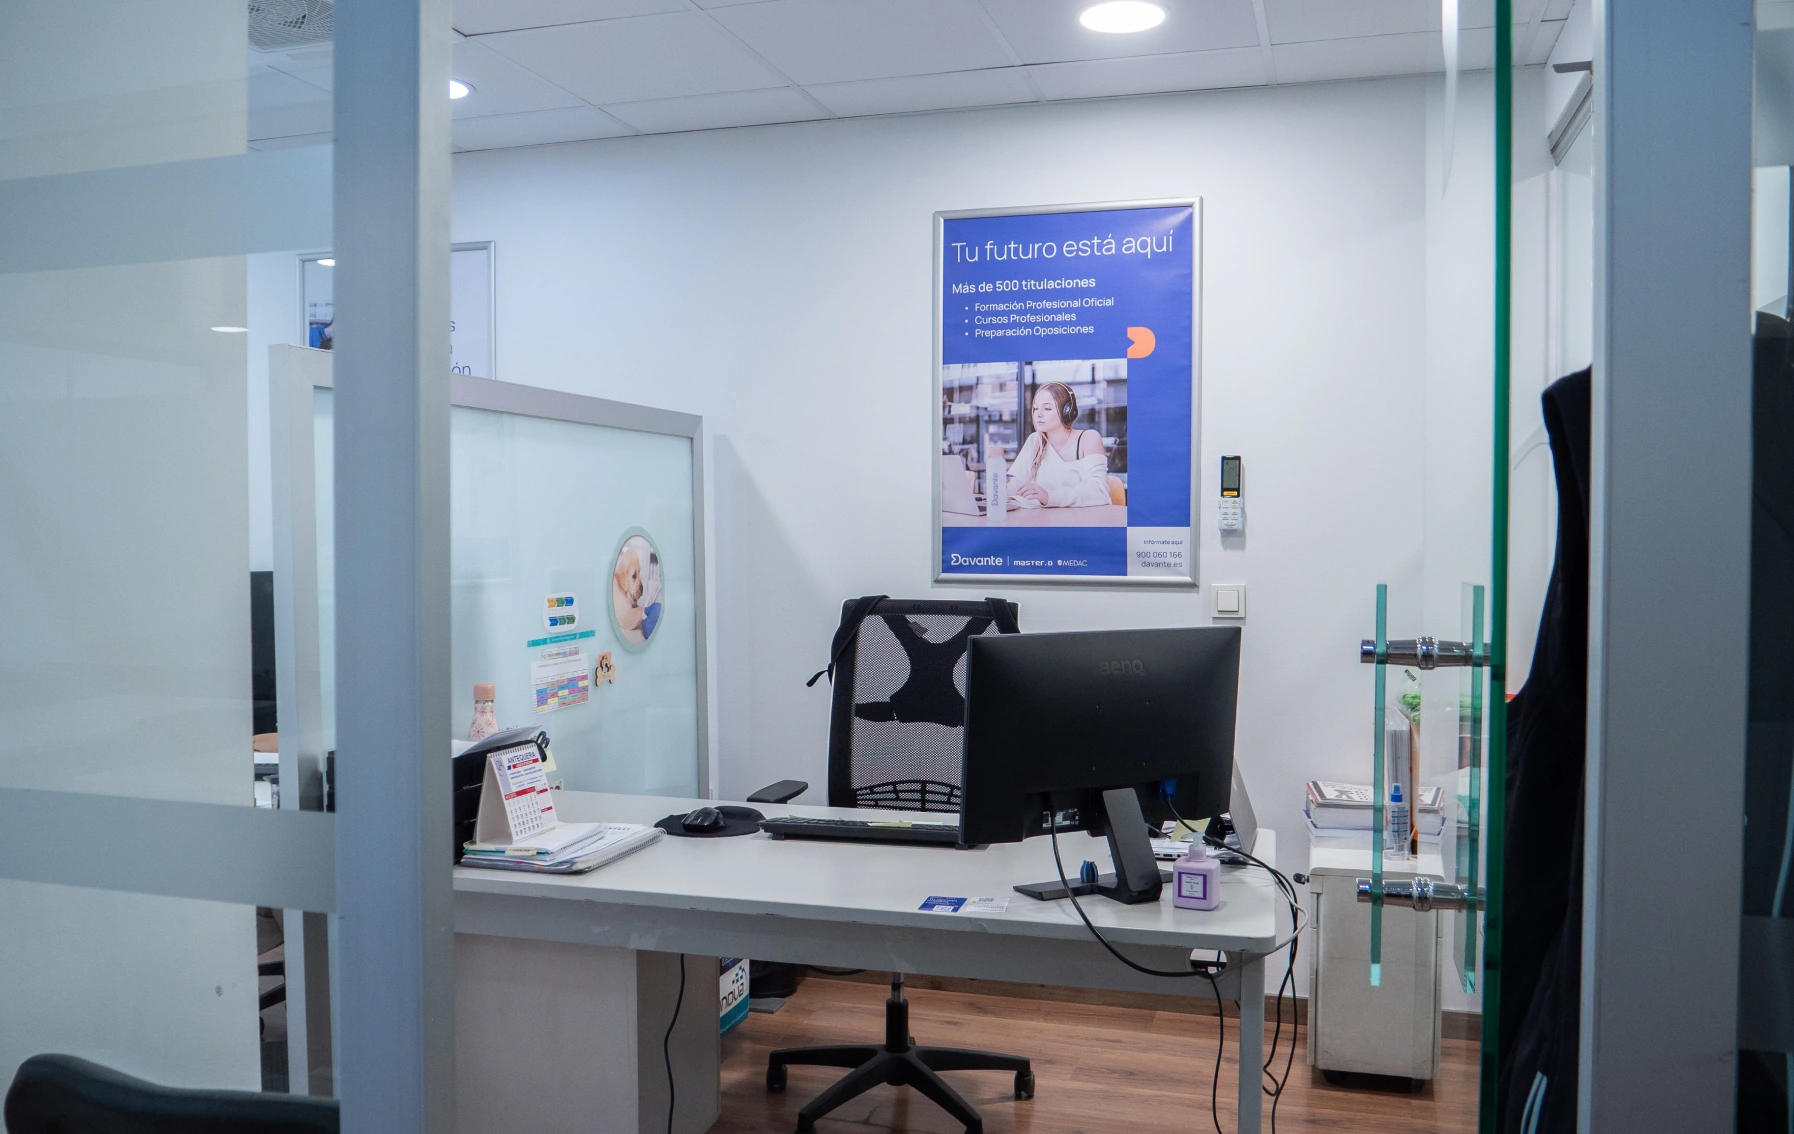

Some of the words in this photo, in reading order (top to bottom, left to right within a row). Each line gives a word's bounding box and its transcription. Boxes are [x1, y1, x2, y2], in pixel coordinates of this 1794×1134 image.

[952, 242, 979, 262] Tu
[984, 240, 1057, 260] futuro
[1063, 233, 1115, 257] está
[1122, 229, 1174, 259] aquí
[952, 281, 976, 294] Más
[978, 281, 994, 292] de
[995, 280, 1019, 291] 500
[1021, 277, 1096, 290] titulaciones
[975, 300, 1025, 312] Formación
[1026, 298, 1080, 310] Profesional
[1082, 297, 1114, 307] Oficial
[975, 315, 1008, 325] Cursos
[1010, 312, 1077, 323] Profesionales
[975, 326, 1032, 339] Preparación
[1033, 325, 1094, 337] Oposiciones
[951, 553, 1003, 566] Davante
[1062, 559, 1088, 567] MEDAC
[1141, 560, 1183, 568] davante.es
[507, 751, 537, 765] ANTEQUERA
